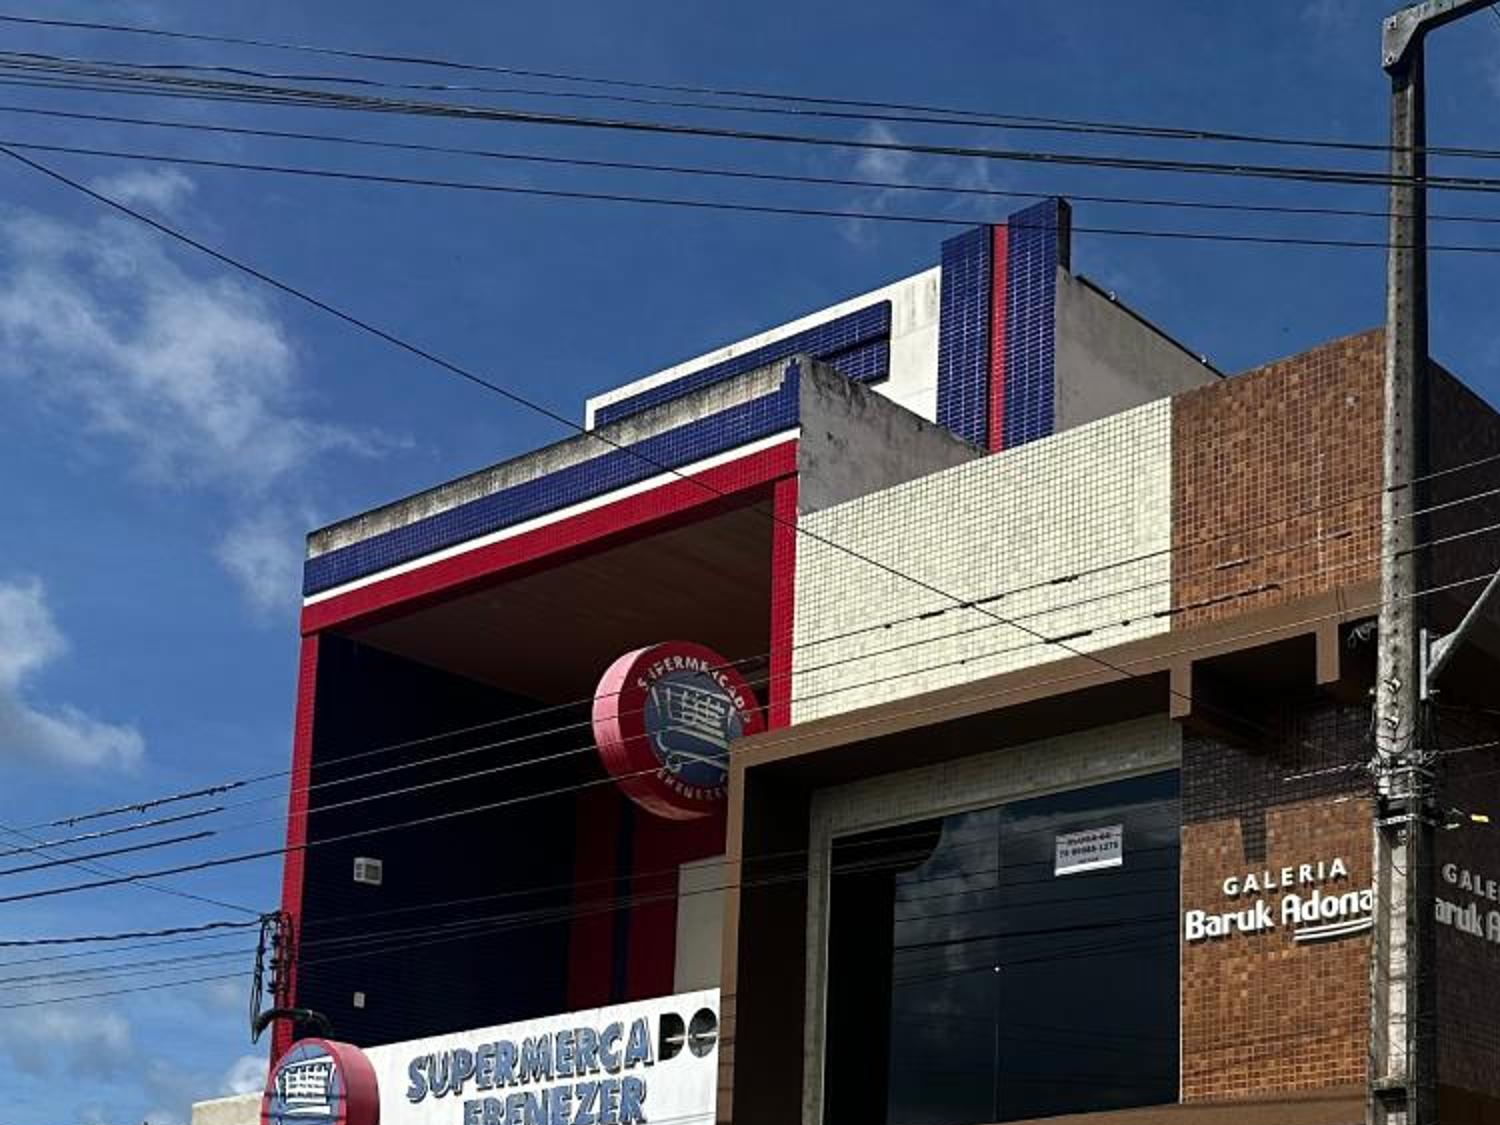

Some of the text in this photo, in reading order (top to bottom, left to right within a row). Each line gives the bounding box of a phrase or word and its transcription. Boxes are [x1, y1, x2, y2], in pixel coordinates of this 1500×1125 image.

[1222, 857, 1347, 896] GALERIA
[1185, 889, 1373, 941] Baruk Adona
[1434, 896, 1483, 937] aruk
[406, 1007, 718, 1103] SUPERMERCADO
